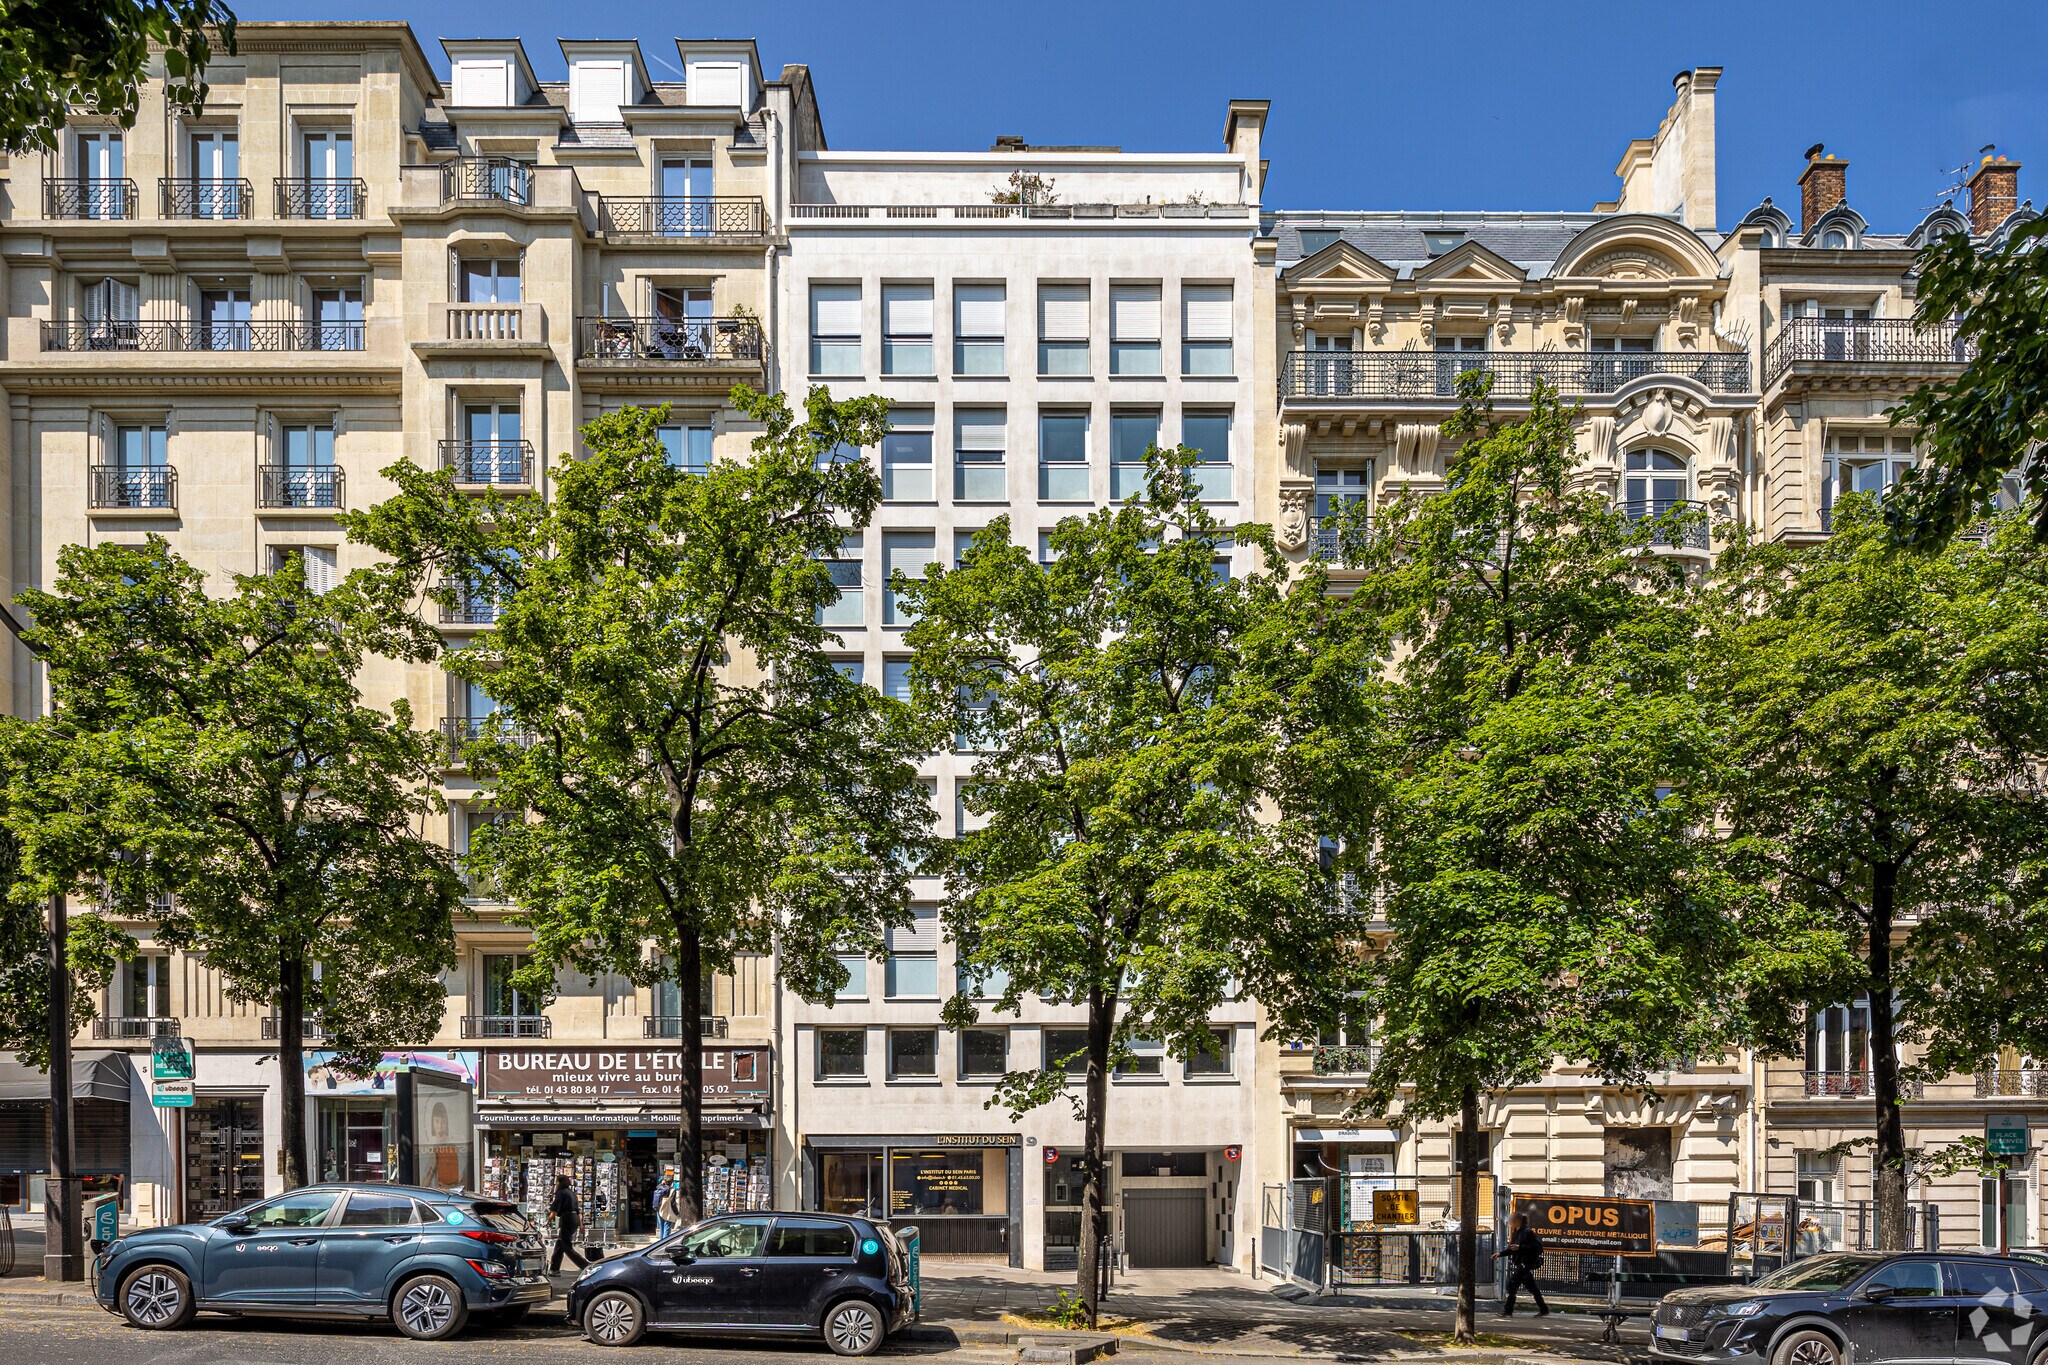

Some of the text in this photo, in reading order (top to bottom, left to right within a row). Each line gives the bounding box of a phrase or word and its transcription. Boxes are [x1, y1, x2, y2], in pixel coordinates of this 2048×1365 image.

[499, 1048, 725, 1070] BUREAU DE L'ÉTLE
[552, 1072, 593, 1082] mieux
[598, 1072, 630, 1082] vivre
[634, 1074, 651, 1082] au
[526, 1085, 730, 1094] tél. 01 43 80 84 17 fax. 01 4 05 02
[480, 1114, 527, 1122] Fournitures
[530, 1114, 541, 1122] de
[543, 1114, 573, 1122] Bureau
[584, 1114, 640, 1123] Informatique
[937, 1135, 1017, 1145] L'INSTITUT DU SEIN
[1026, 1136, 1037, 1147] 9
[1548, 1205, 1620, 1227] OPUS
[1537, 1228, 1562, 1236] ŒUVRE
[1567, 1229, 1606, 1238] STRUCTURE
[683, 1275, 714, 1285] ubeeqo
